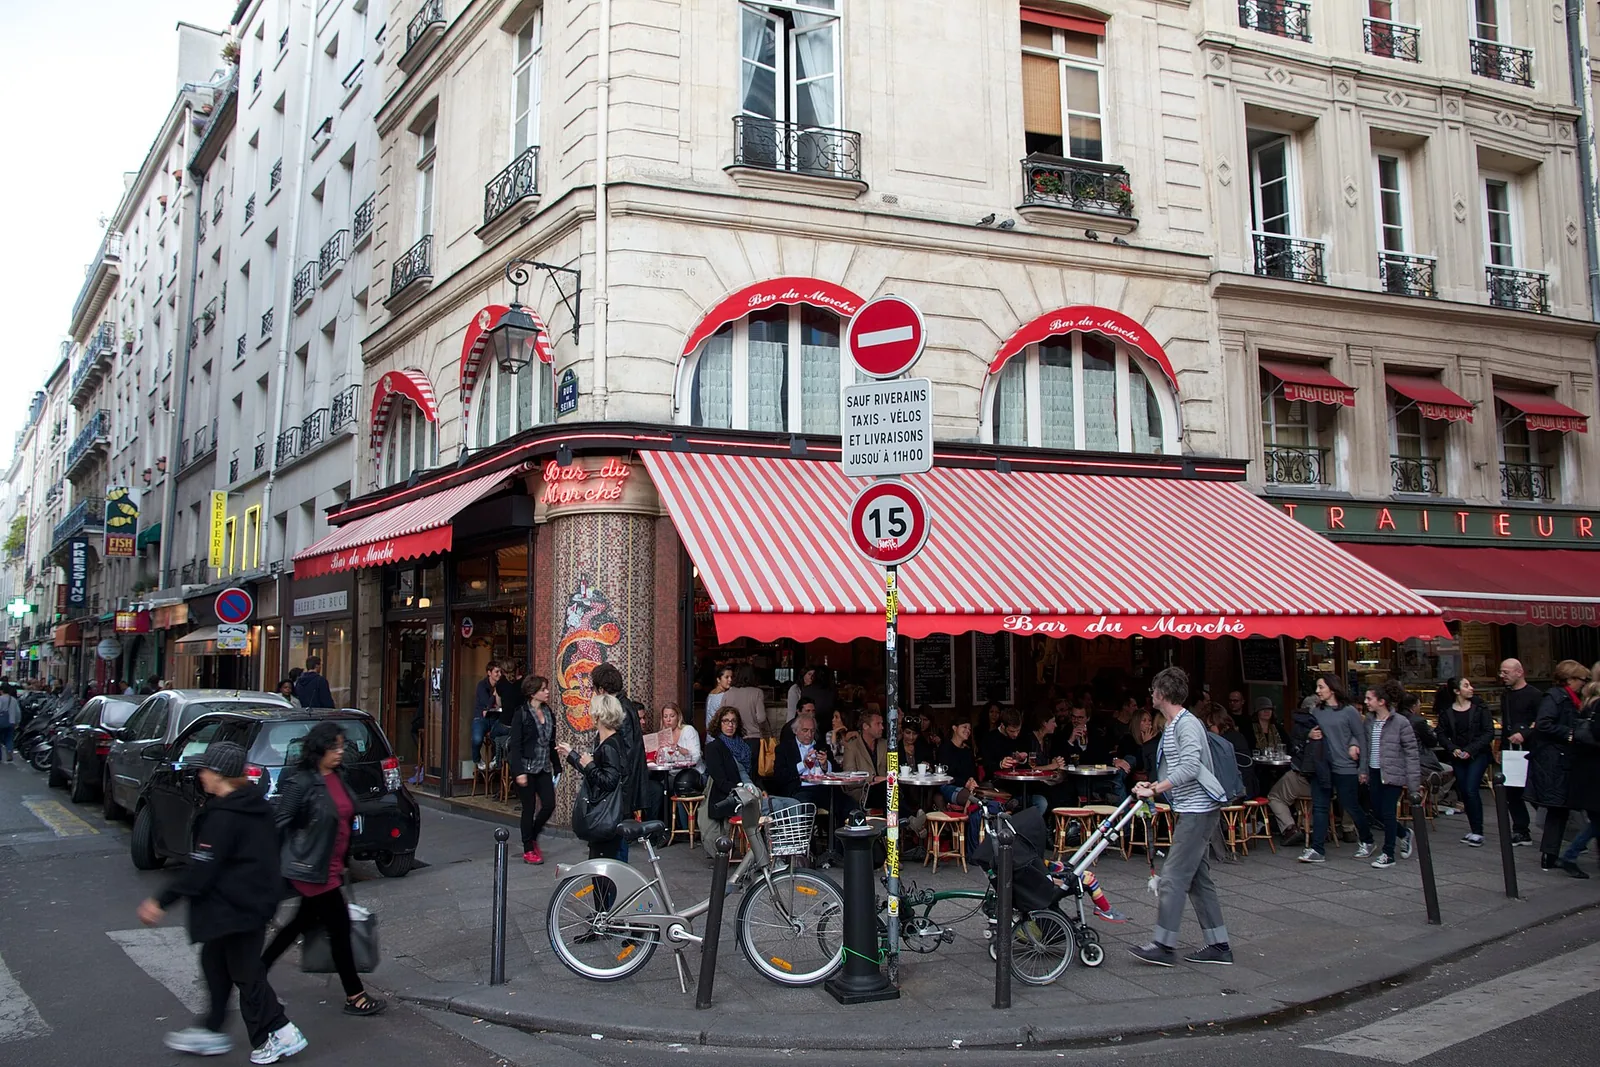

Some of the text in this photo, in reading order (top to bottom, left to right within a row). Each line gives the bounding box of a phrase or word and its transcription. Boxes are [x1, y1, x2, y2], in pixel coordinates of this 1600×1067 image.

[748, 288, 855, 313] Bar du Marché
[1049, 316, 1140, 342] Bar du Marché
[563, 384, 573, 396] RUE
[846, 389, 927, 408] SAUF RIVERAINS
[1293, 384, 1345, 403] TRAITEUR
[560, 399, 575, 412] SEINE
[851, 413, 879, 427] TAXIS
[890, 408, 922, 424] VÉLOS
[1531, 416, 1555, 429] SALON
[1556, 417, 1567, 429] DE
[849, 429, 924, 447] ET LIVRAISONS
[893, 448, 923, 463] 11H00
[543, 459, 629, 481] Bar du
[540, 480, 624, 503] Marché
[213, 493, 224, 566] CREPERIE
[868, 507, 907, 538] 15
[1284, 504, 1593, 536] TRAITEUR
[110, 538, 132, 547] FISH
[330, 541, 395, 569] Bar du Marché
[71, 542, 87, 602] PRESSING
[319, 598, 326, 609] DE
[1532, 605, 1597, 621] DELICE BUCI
[1003, 615, 1246, 634] Bar du Marché
[890, 754, 898, 772] REK
